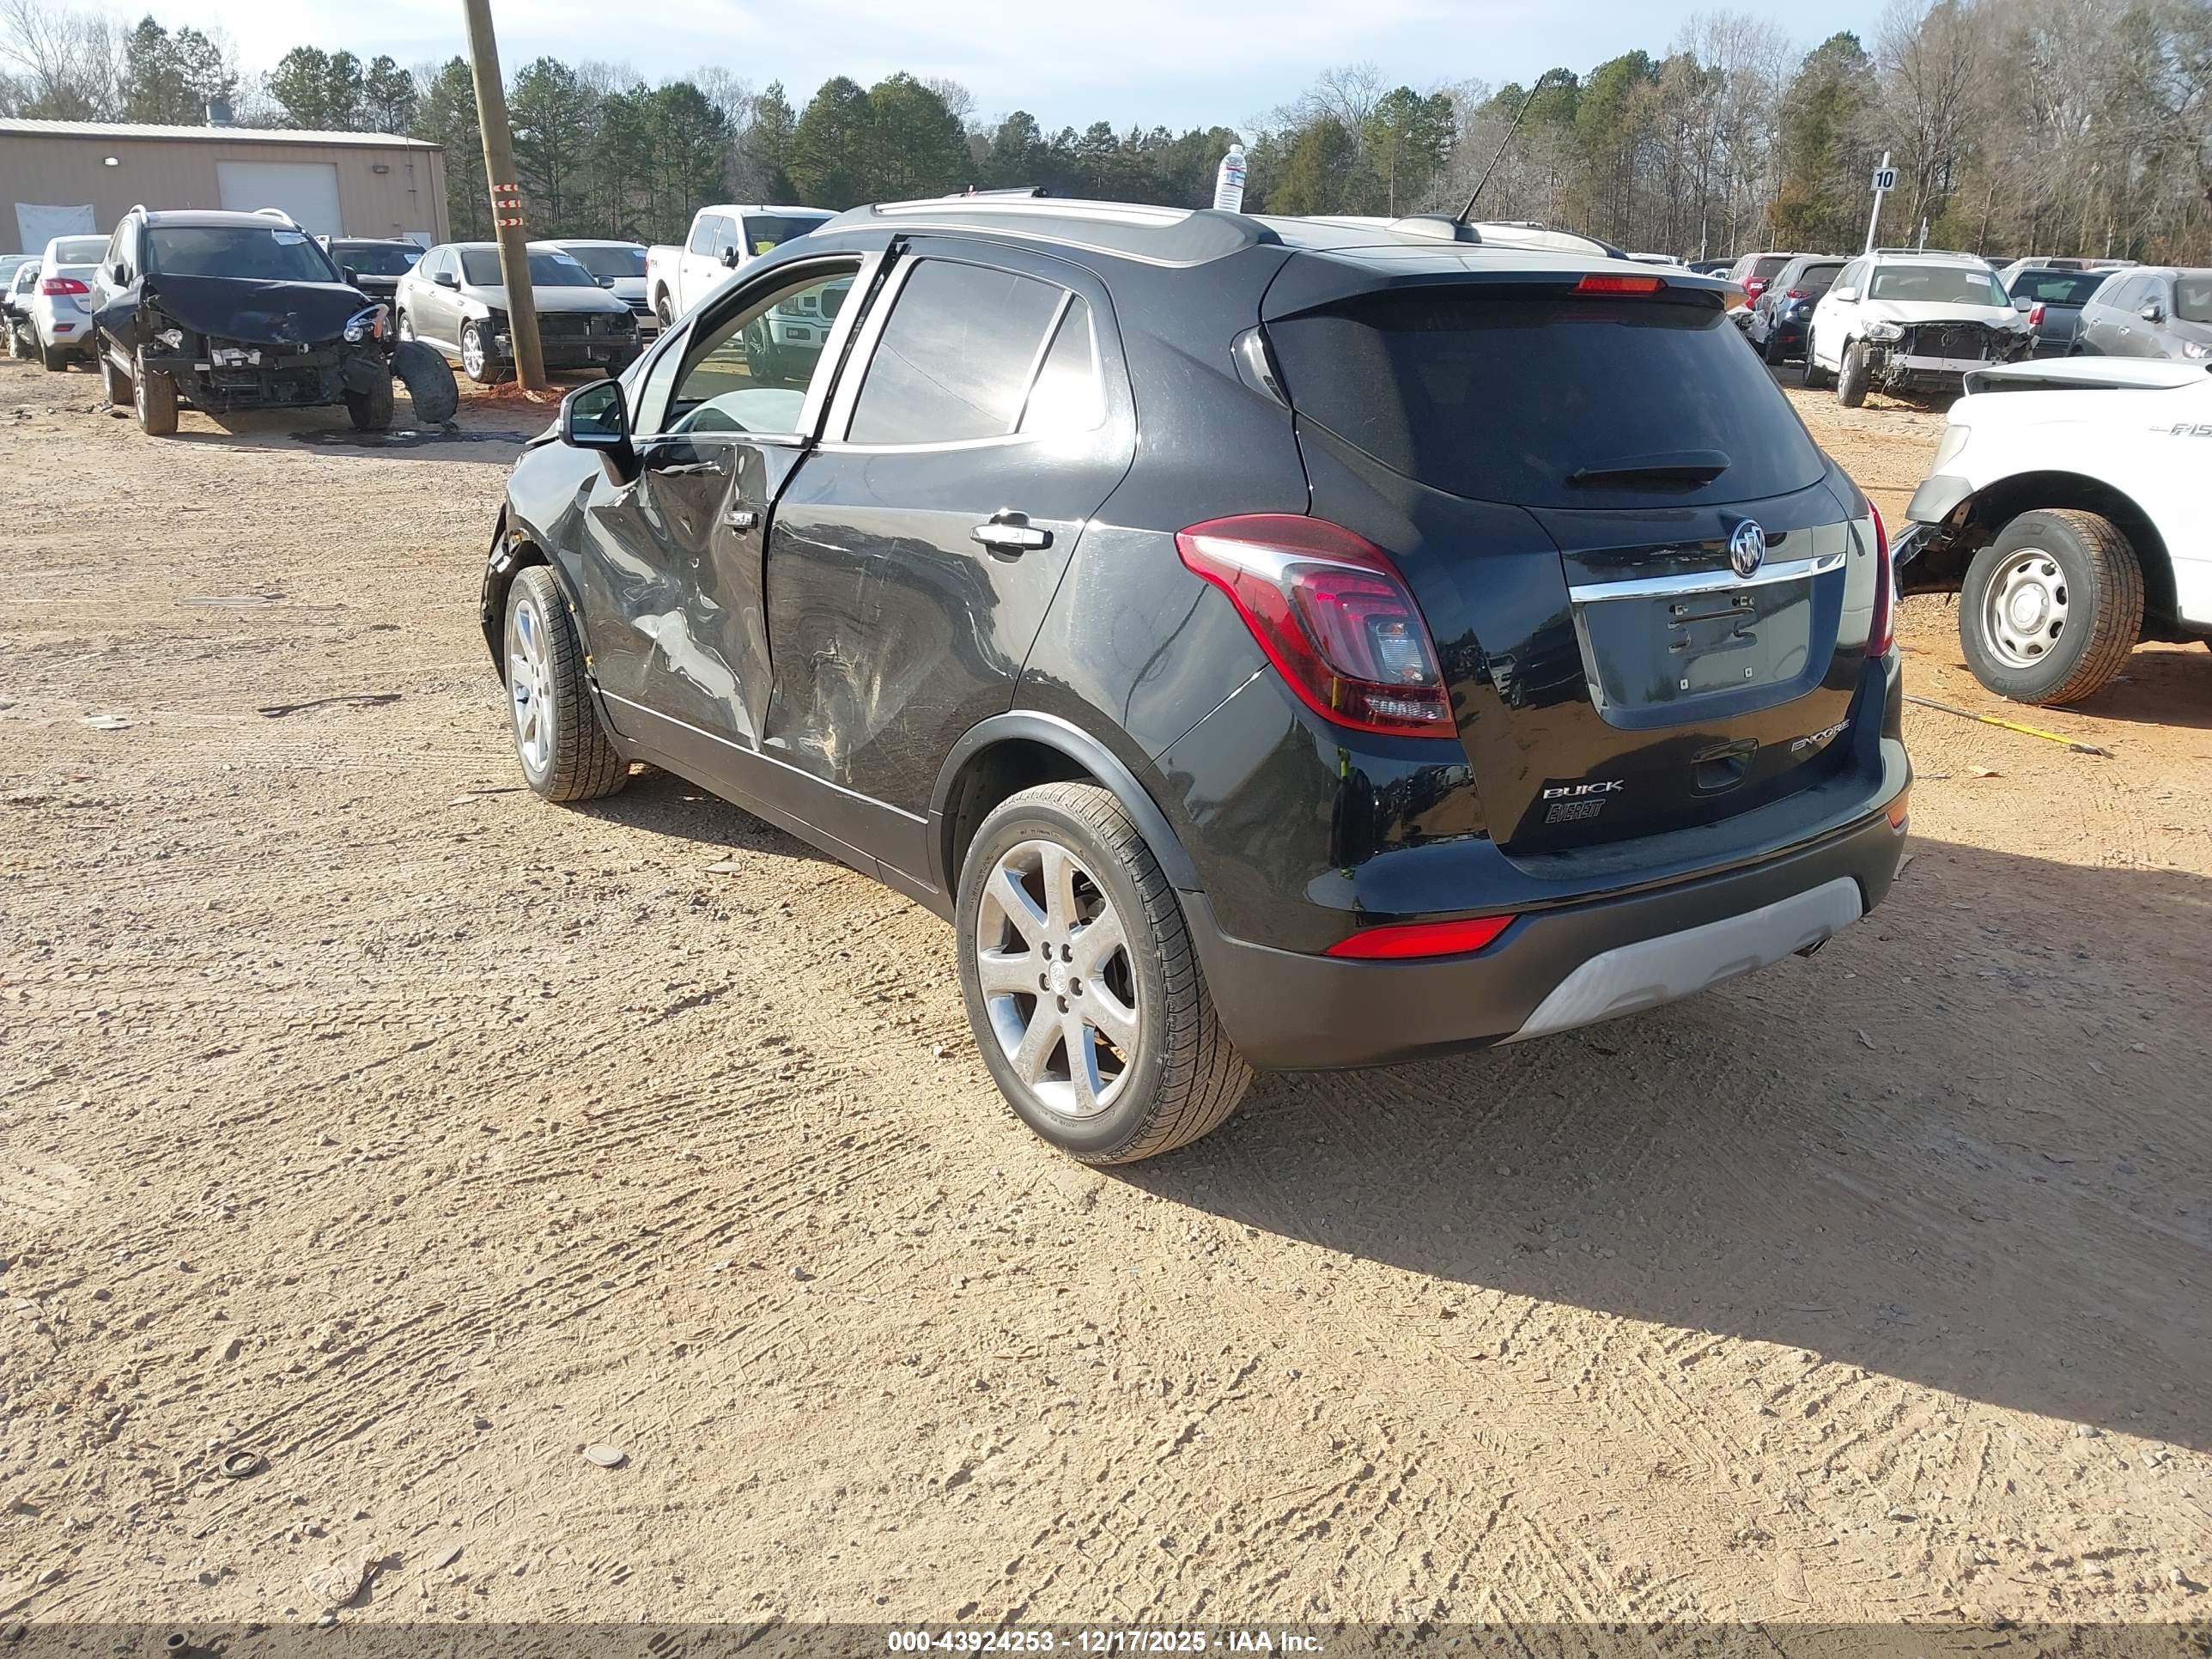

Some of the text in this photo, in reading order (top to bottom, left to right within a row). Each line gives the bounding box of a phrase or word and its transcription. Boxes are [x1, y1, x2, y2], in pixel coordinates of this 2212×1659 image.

[1875, 171, 1894, 188] 10
[1790, 719, 1850, 753] ENCORE
[1543, 779, 1625, 799] BUICK
[1546, 799, 1606, 823] EVERETT
